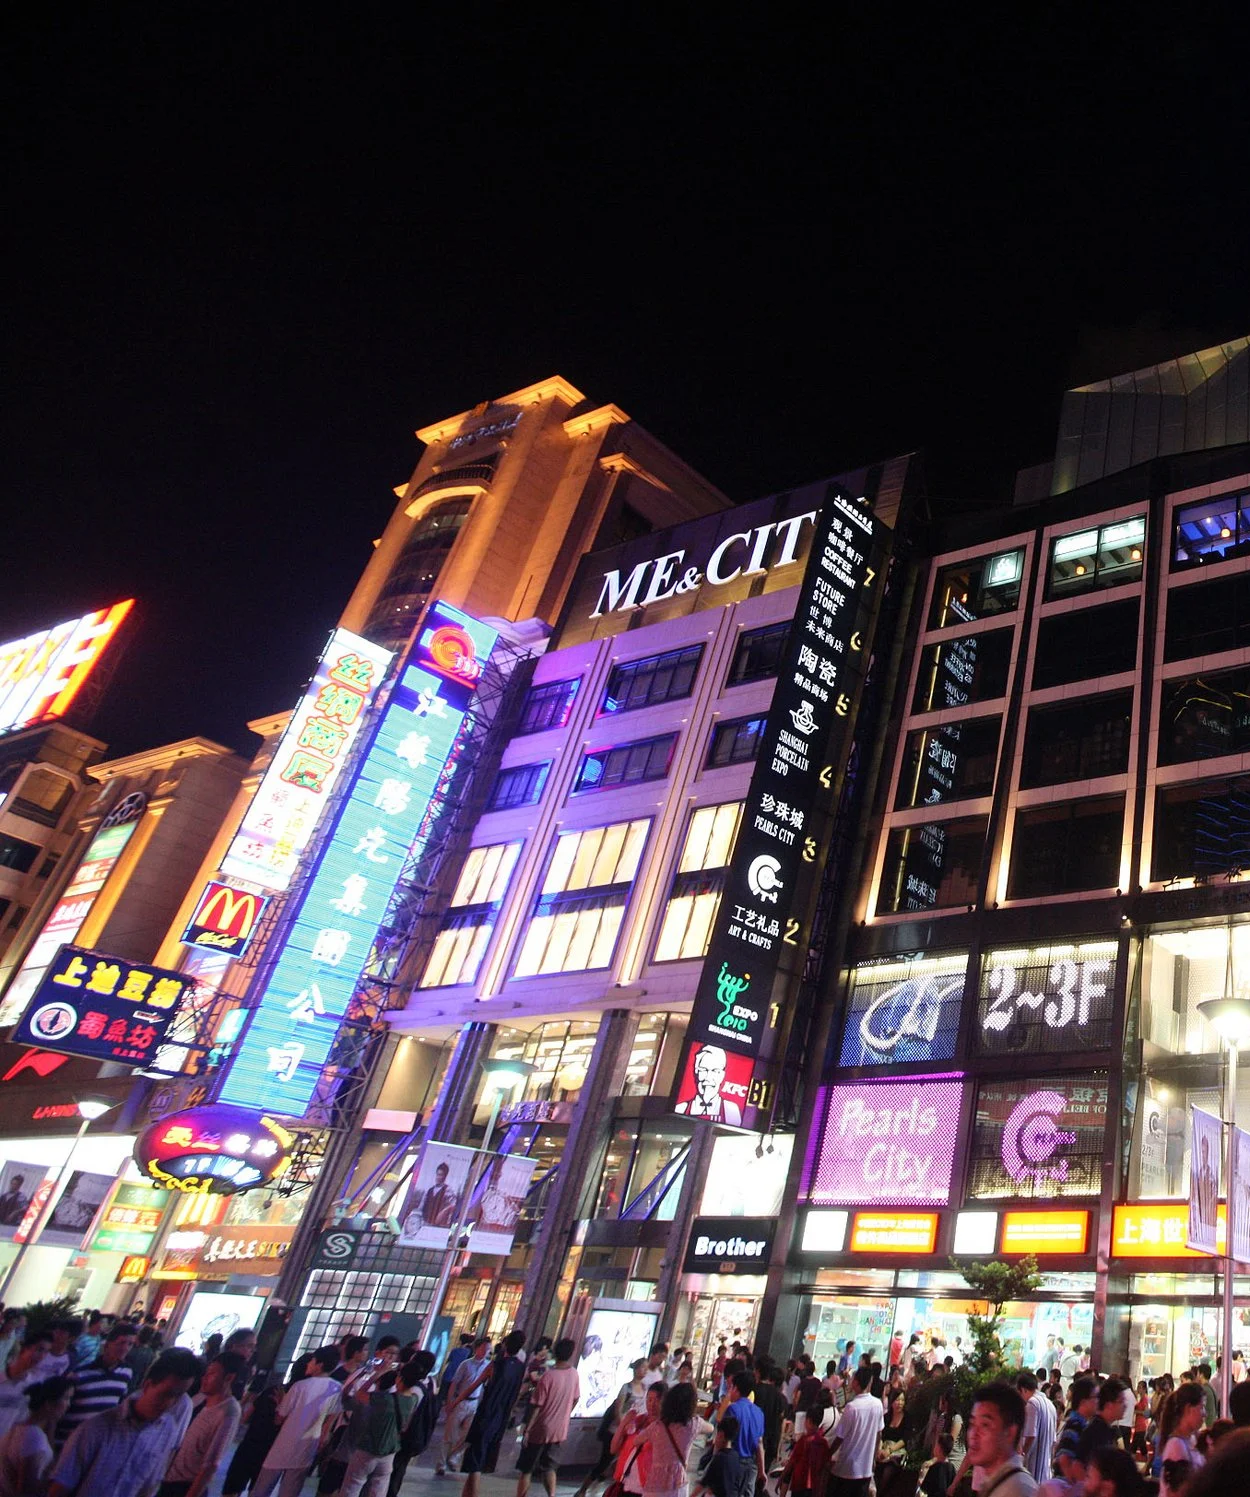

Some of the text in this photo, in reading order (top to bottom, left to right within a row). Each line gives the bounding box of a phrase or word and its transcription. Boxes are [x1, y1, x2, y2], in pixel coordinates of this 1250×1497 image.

[831, 518, 854, 542] 观景
[824, 547, 852, 574] COFFEE
[828, 532, 864, 566] 咖啡餐厅
[821, 556, 856, 590] RESTAURANT
[812, 590, 838, 616] STORE
[816, 577, 845, 607] FUTURE
[809, 605, 833, 630] 世博
[805, 619, 844, 654] 未来商店
[798, 644, 837, 688] 陶瓷
[793, 672, 829, 704] 精品商场
[775, 743, 811, 772] PORCELAIN
[778, 730, 810, 756] SHANGHAI
[771, 757, 789, 777] EXPO
[760, 792, 805, 831] 珍珠城
[754, 815, 796, 847] PEARLS CITY
[732, 904, 780, 938] 工艺礼品
[728, 924, 741, 940] ART
[748, 932, 773, 951] CRAFTS
[720, 1080, 749, 1098] KFC
[694, 1236, 766, 1257] Brother
